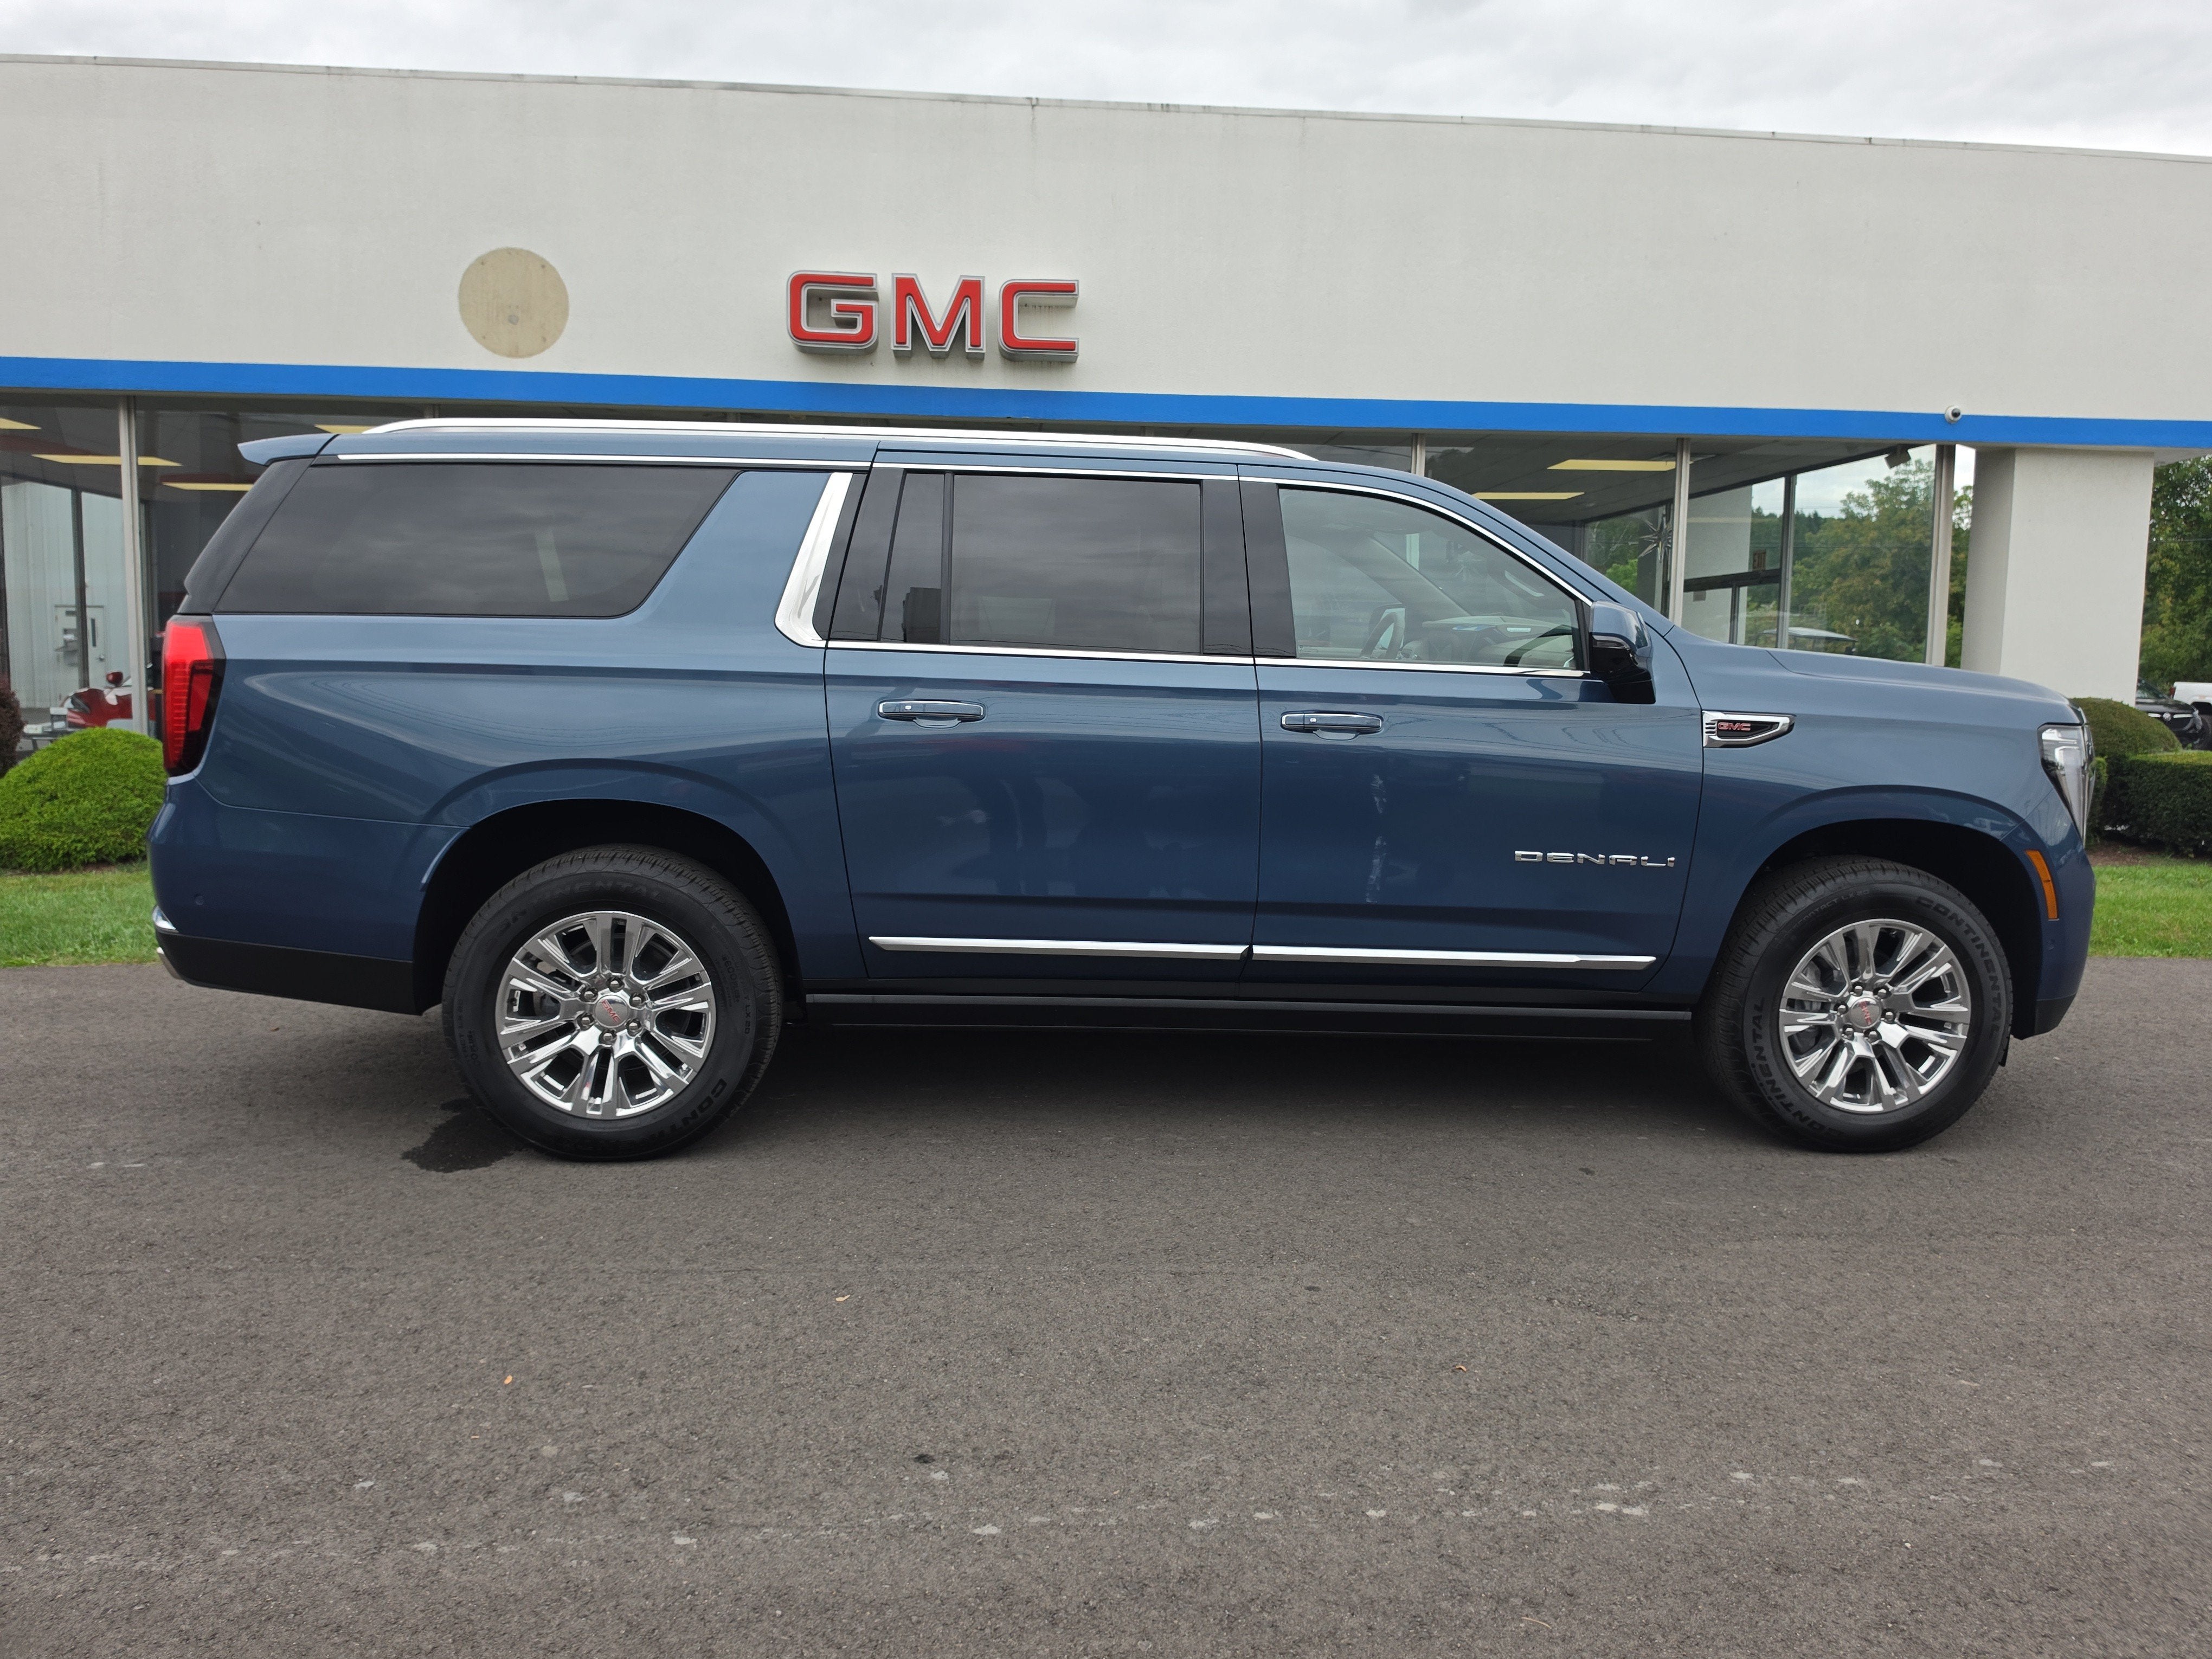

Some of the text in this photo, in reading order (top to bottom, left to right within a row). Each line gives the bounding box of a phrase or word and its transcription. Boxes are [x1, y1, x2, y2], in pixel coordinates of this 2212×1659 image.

[787, 270, 1079, 359] GMC
[1718, 722, 1751, 731] GMC
[1515, 851, 1675, 867] DENALI
[1915, 896, 2002, 1038] CONTINENTAL
[601, 999, 621, 1025] GMC
